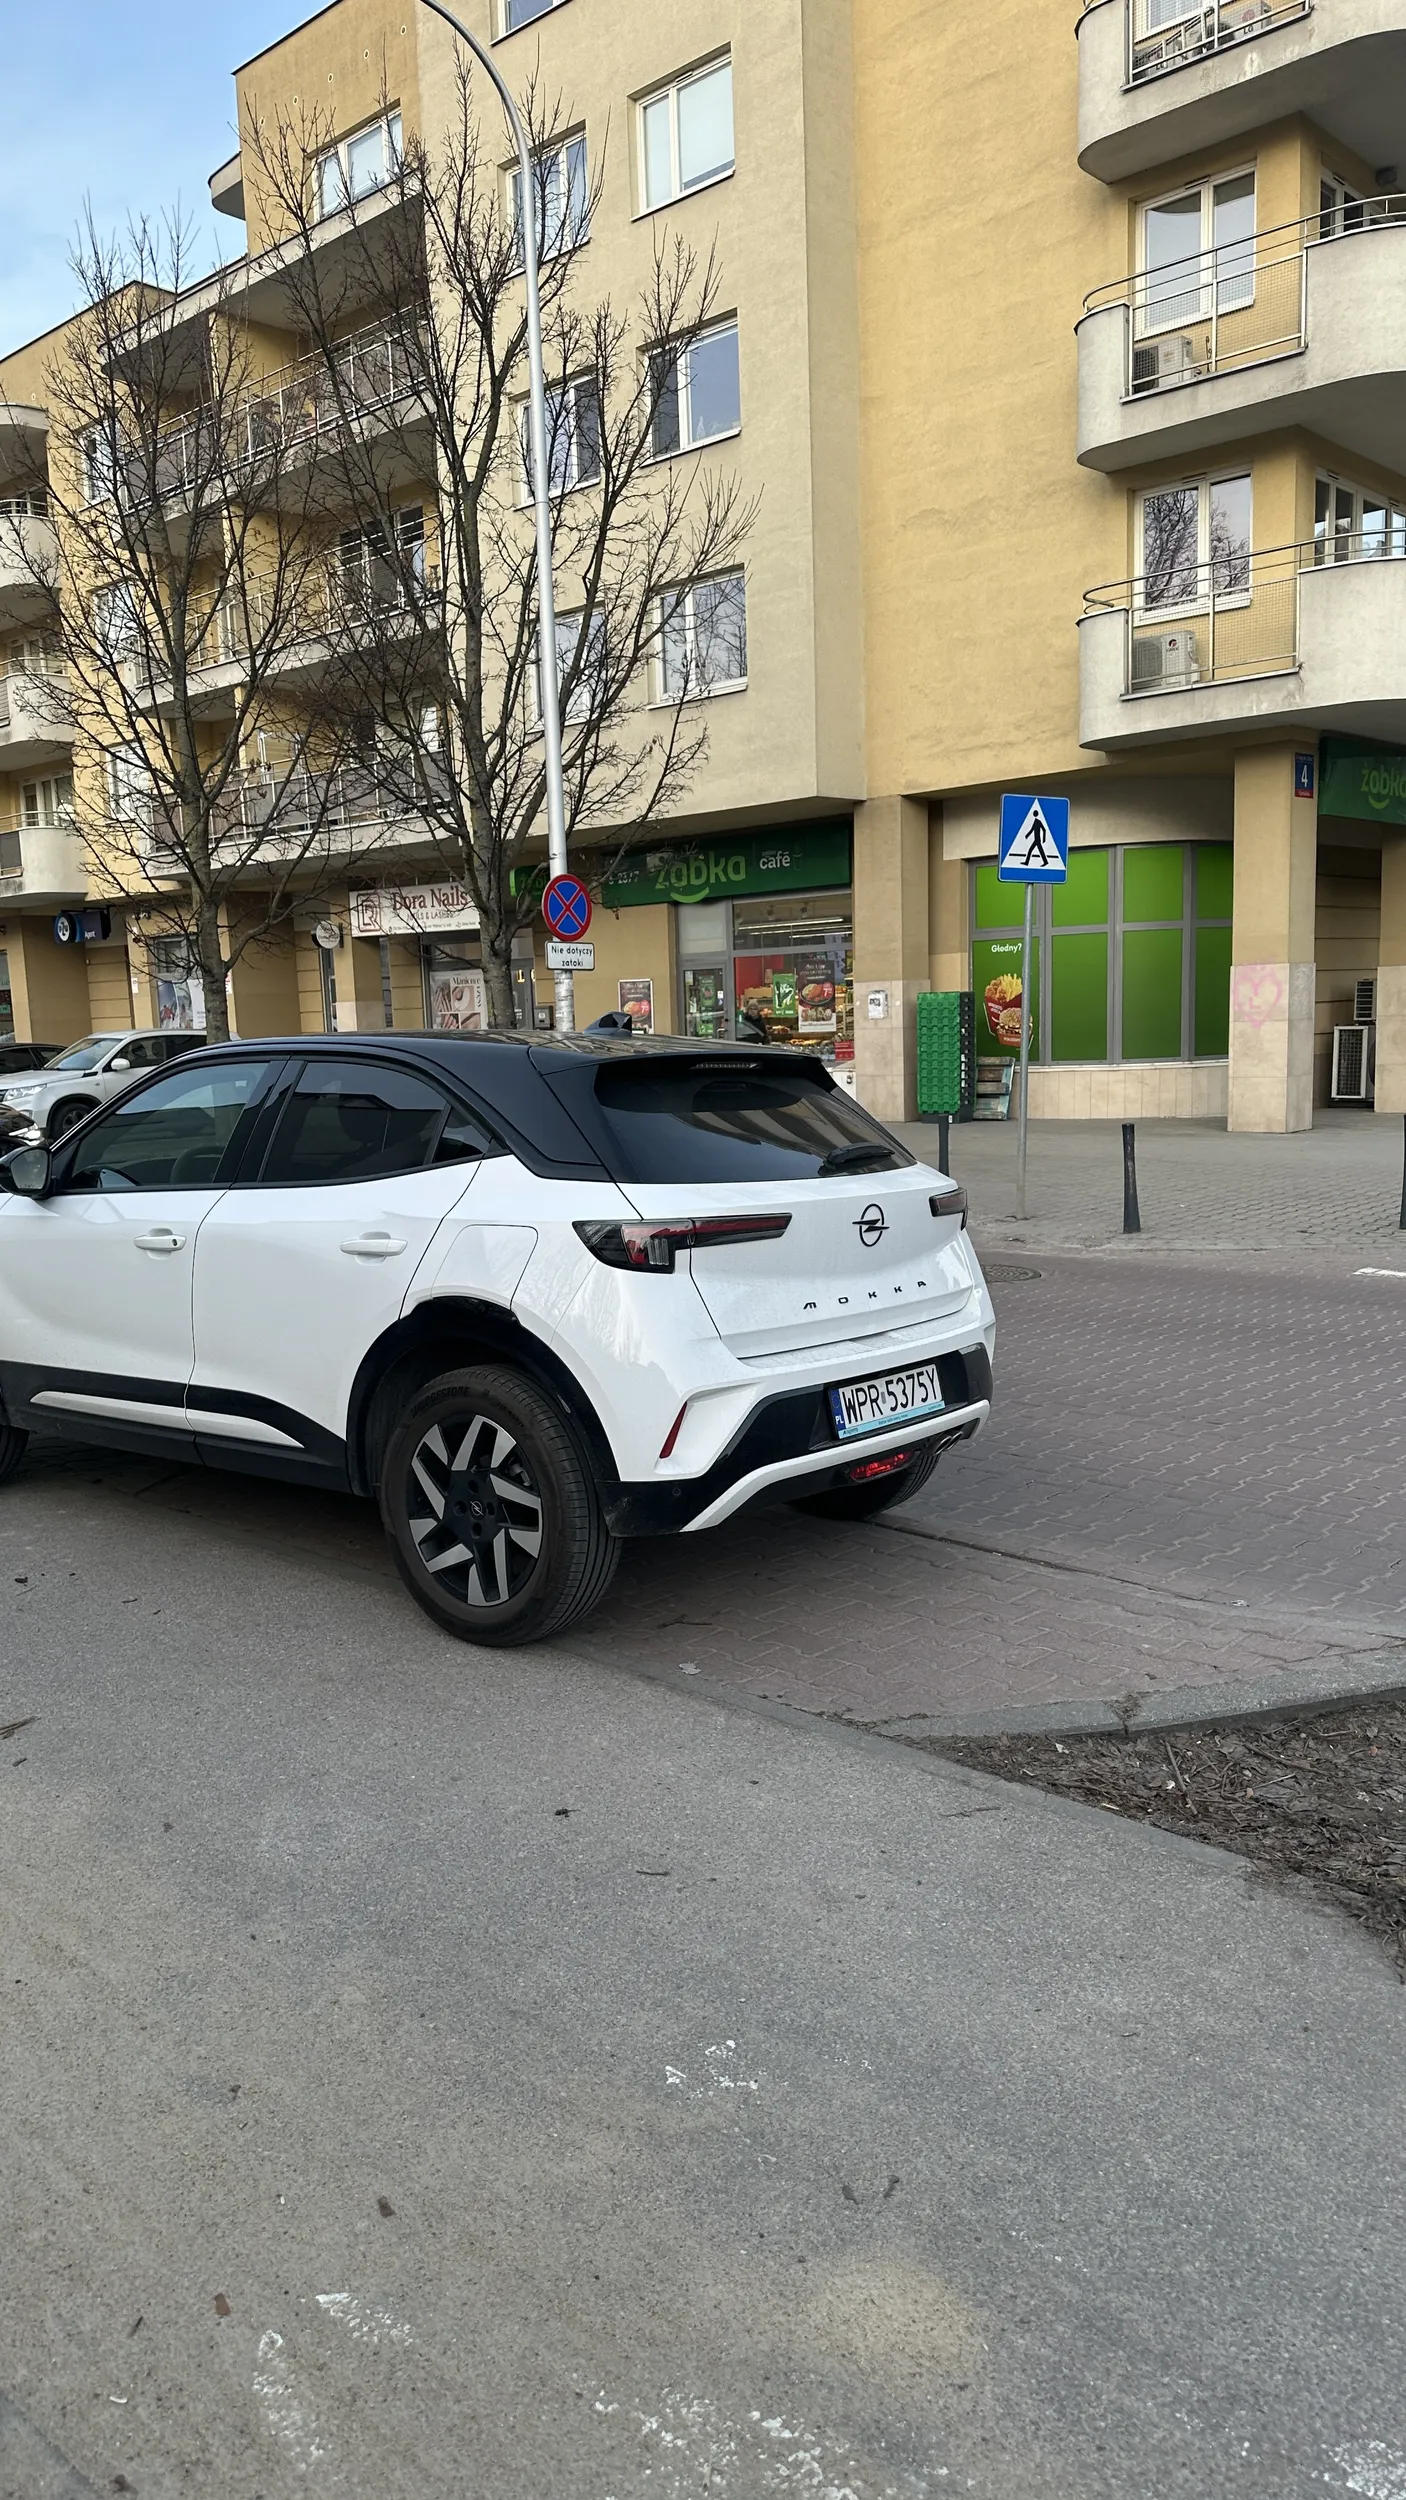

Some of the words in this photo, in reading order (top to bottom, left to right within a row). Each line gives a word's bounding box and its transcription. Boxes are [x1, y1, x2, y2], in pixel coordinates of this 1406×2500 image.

[1301, 764, 1308, 788] 4
[429, 885, 468, 908] Nails
[551, 945, 564, 954] Nie
[566, 946, 592, 957] dotyczy
[561, 958, 584, 967] zatoki
[803, 1280, 926, 1310] MOKKA
[842, 1383, 883, 1424] WPR
[885, 1368, 937, 1412] 5375Y
[835, 1415, 844, 1425] PL
